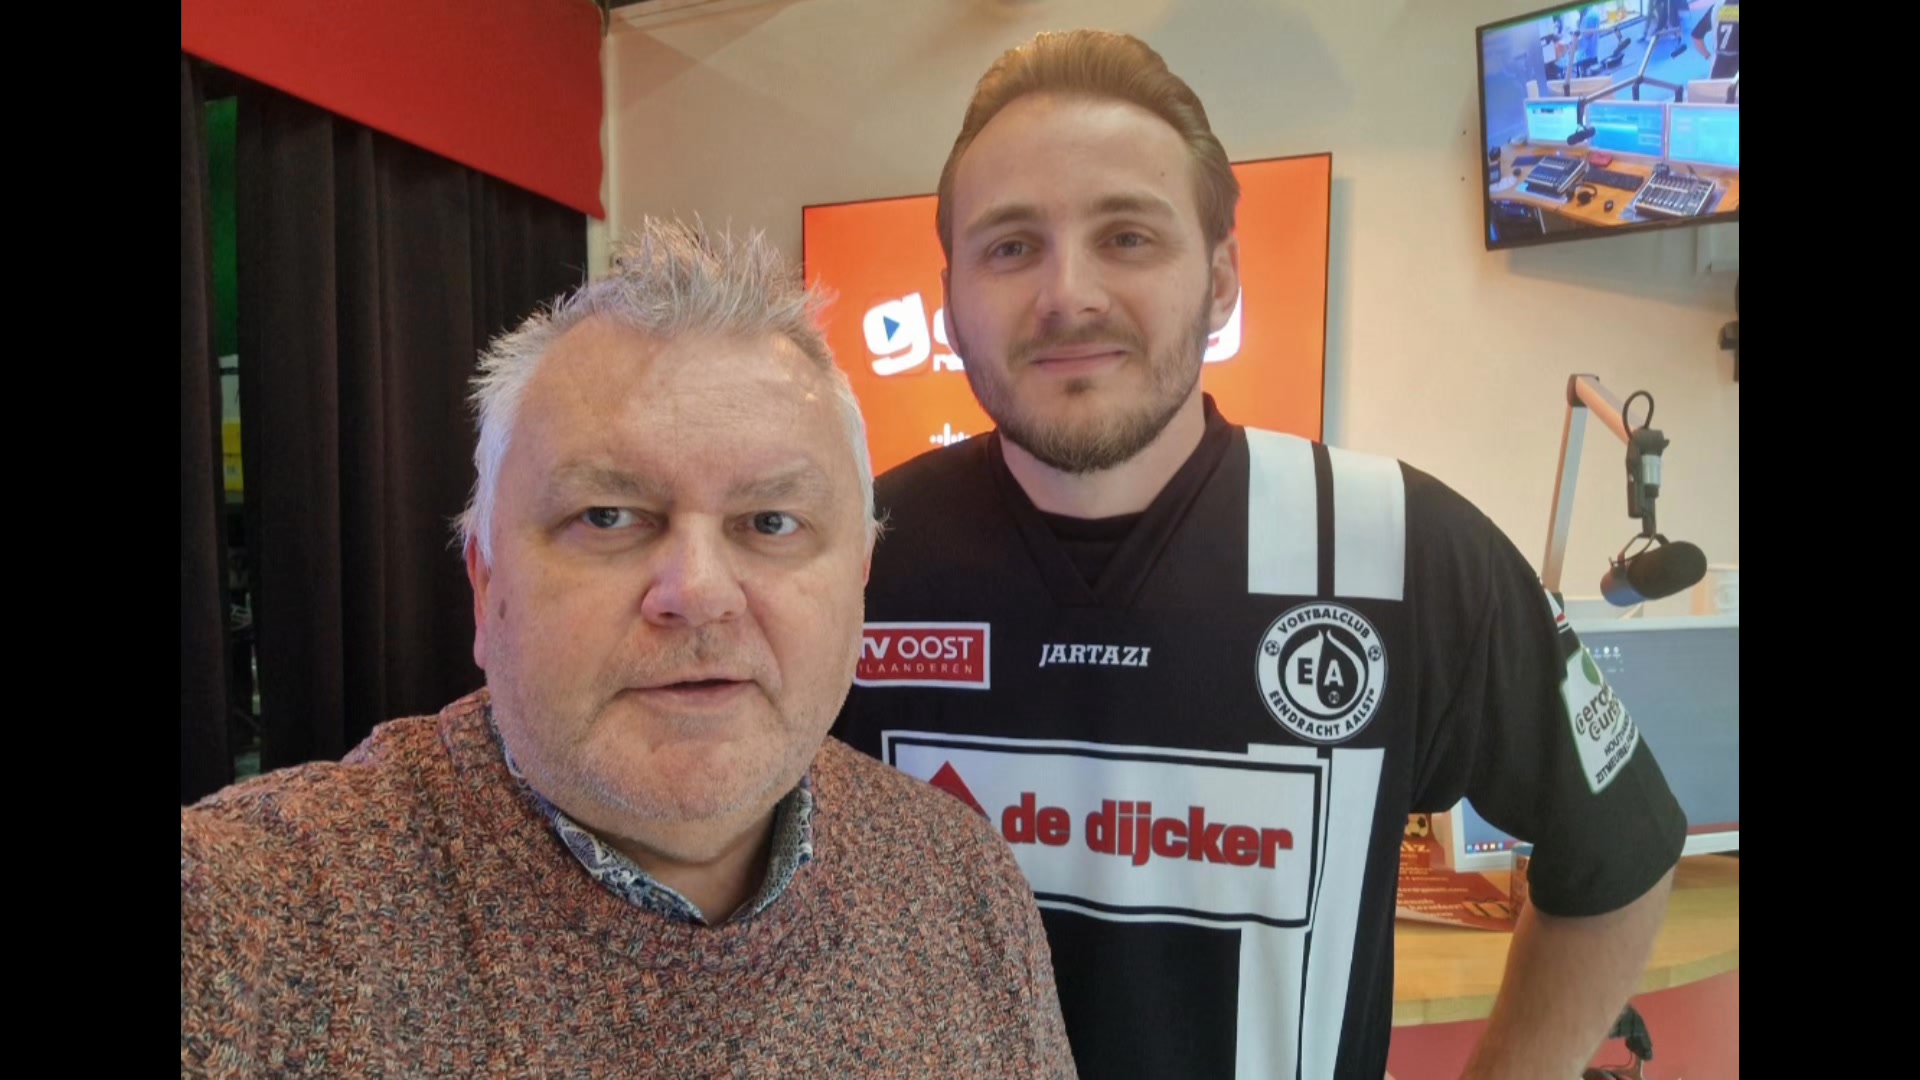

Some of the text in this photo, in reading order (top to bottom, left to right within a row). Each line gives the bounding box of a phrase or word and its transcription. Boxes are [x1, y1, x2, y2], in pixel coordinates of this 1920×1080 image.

[1719, 24, 1733, 50] 7
[1278, 608, 1371, 639] VOETBALCLUB
[898, 635, 974, 660] OOST
[1039, 644, 1151, 667] JARTAZI
[1269, 690, 1340, 736] EENDRACHT
[1001, 792, 1294, 869] de dijcker
